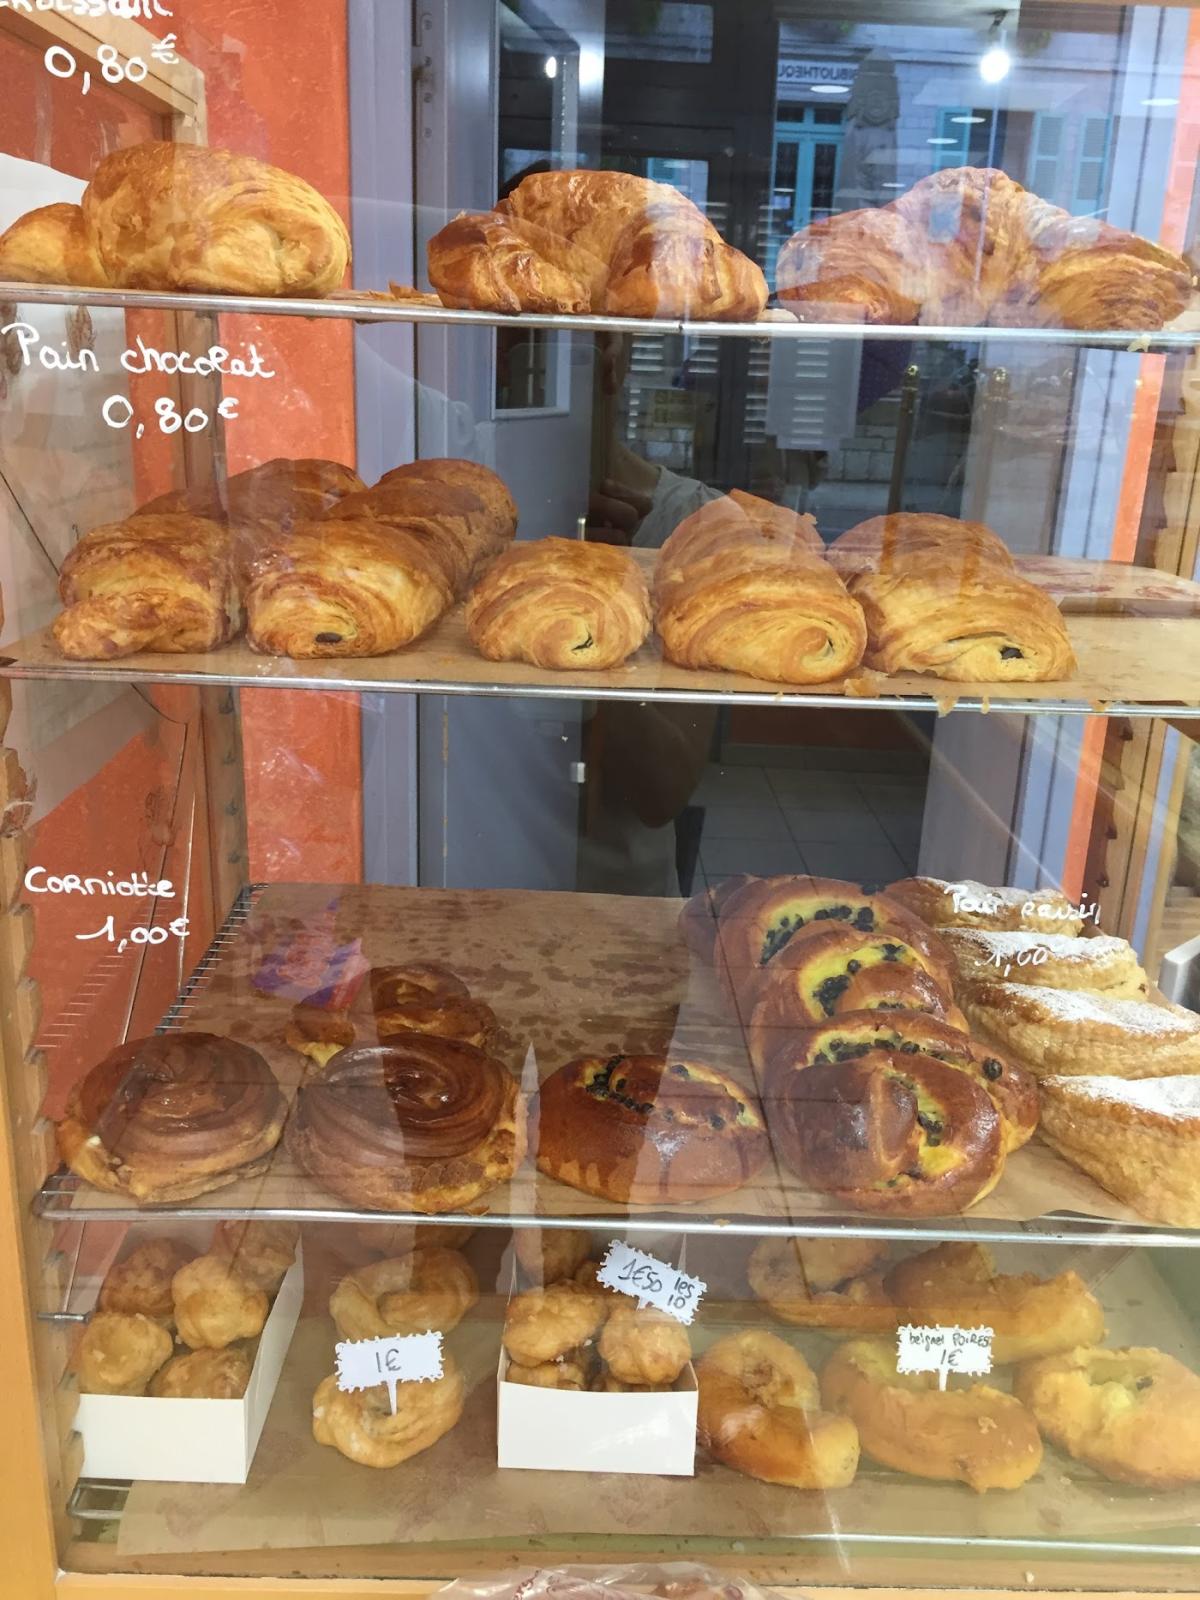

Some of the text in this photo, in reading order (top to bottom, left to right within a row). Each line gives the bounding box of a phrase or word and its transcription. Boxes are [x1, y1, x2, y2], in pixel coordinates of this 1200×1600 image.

[1, 322, 276, 378] Pain chocolat
[75, 915, 190, 953] 1,00€
[375, 1348, 402, 1373] 1€
